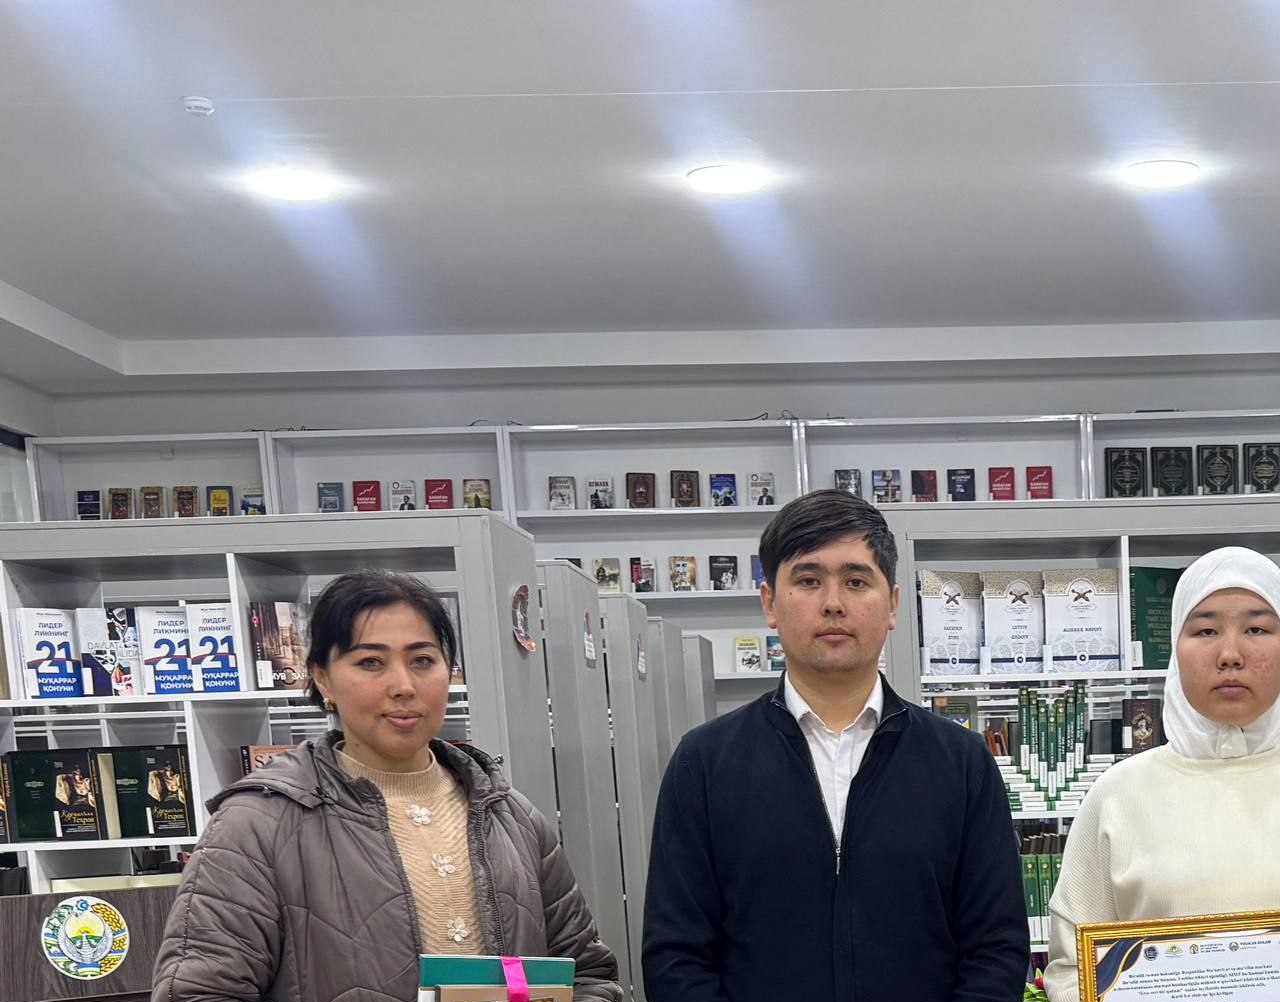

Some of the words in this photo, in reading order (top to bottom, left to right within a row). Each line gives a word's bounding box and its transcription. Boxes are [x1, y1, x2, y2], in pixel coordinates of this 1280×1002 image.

[202, 617, 226, 625] ЛИДЕР
[35, 640, 73, 674] 21
[154, 638, 190, 671] 21
[200, 636, 236, 669] 21
[155, 674, 193, 682] МУҚАРРА
